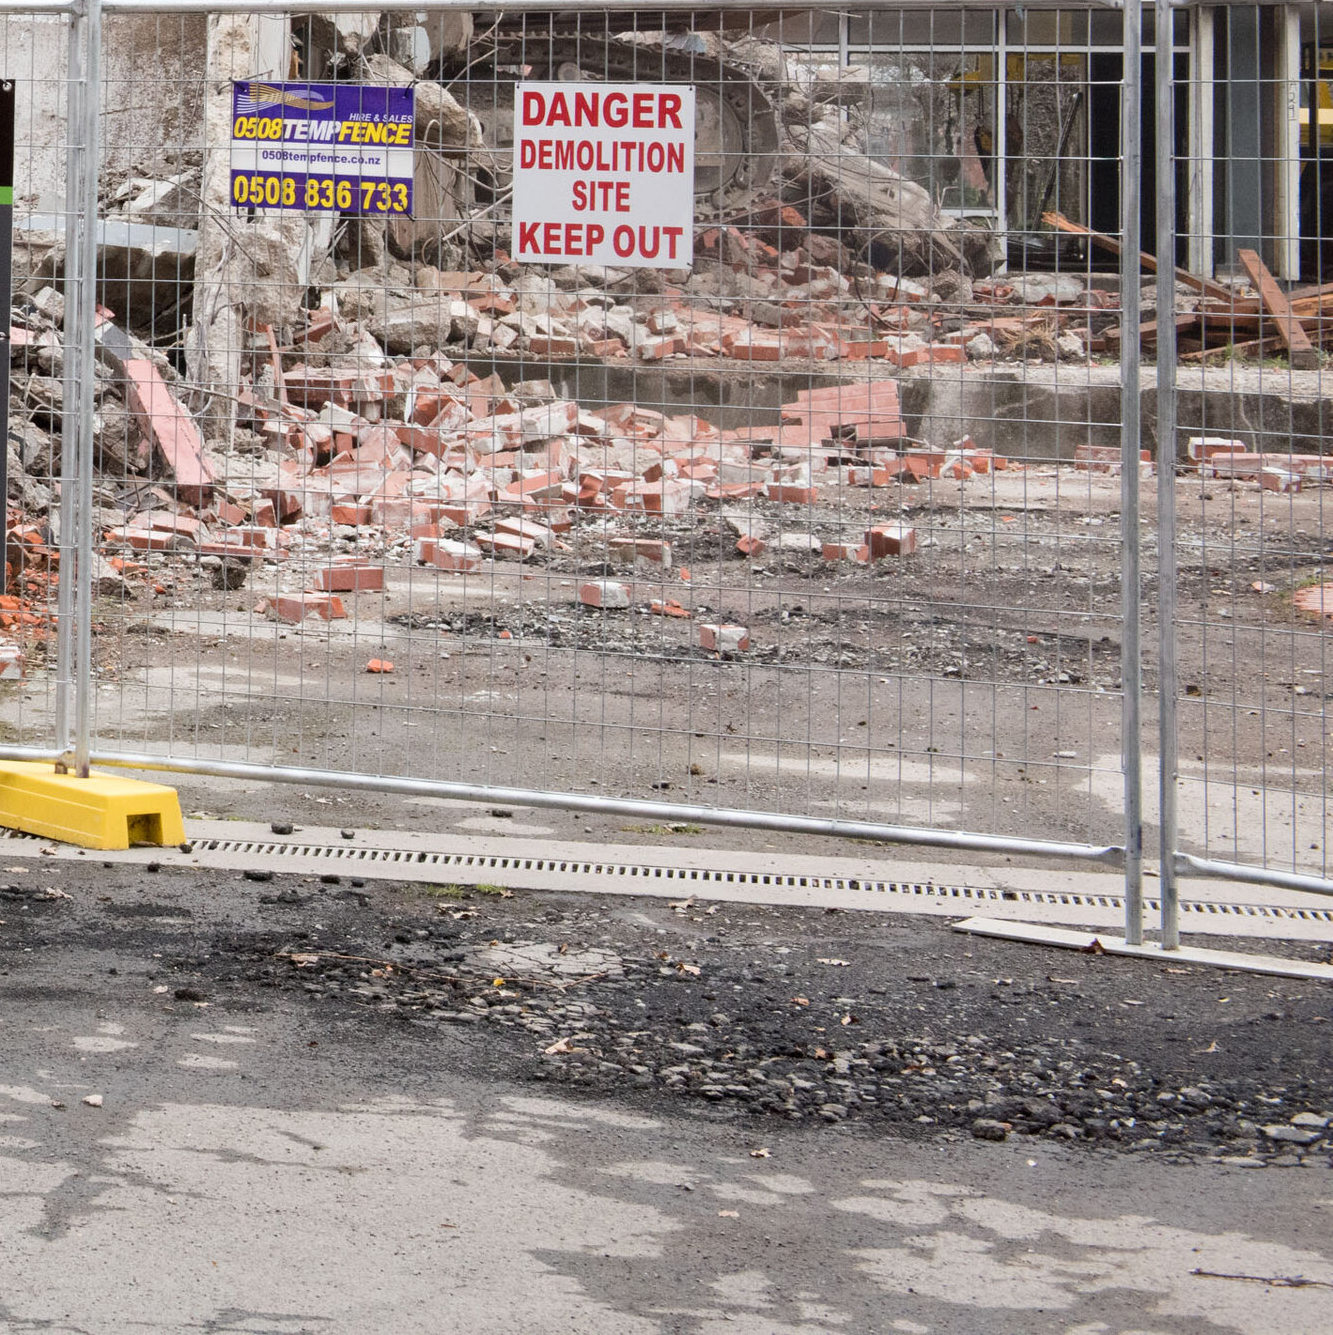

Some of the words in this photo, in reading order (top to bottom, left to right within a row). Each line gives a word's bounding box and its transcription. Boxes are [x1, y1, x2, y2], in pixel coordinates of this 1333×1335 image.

[349, 113, 371, 122] HIRE
[374, 114, 380, 122] &
[383, 115, 413, 123] SALES
[522, 91, 683, 129] DANGER
[234, 117, 413, 144] 0508TEMPFENCE
[262, 150, 381, 165] 0508tempfence.co.nz
[520, 139, 685, 173] DEMOLITION
[234, 175, 296, 206] 0508
[304, 178, 352, 209] 836
[361, 182, 409, 212] 733
[572, 180, 631, 212] SITE
[519, 222, 605, 256] KEEP
[613, 225, 684, 259] OUT
